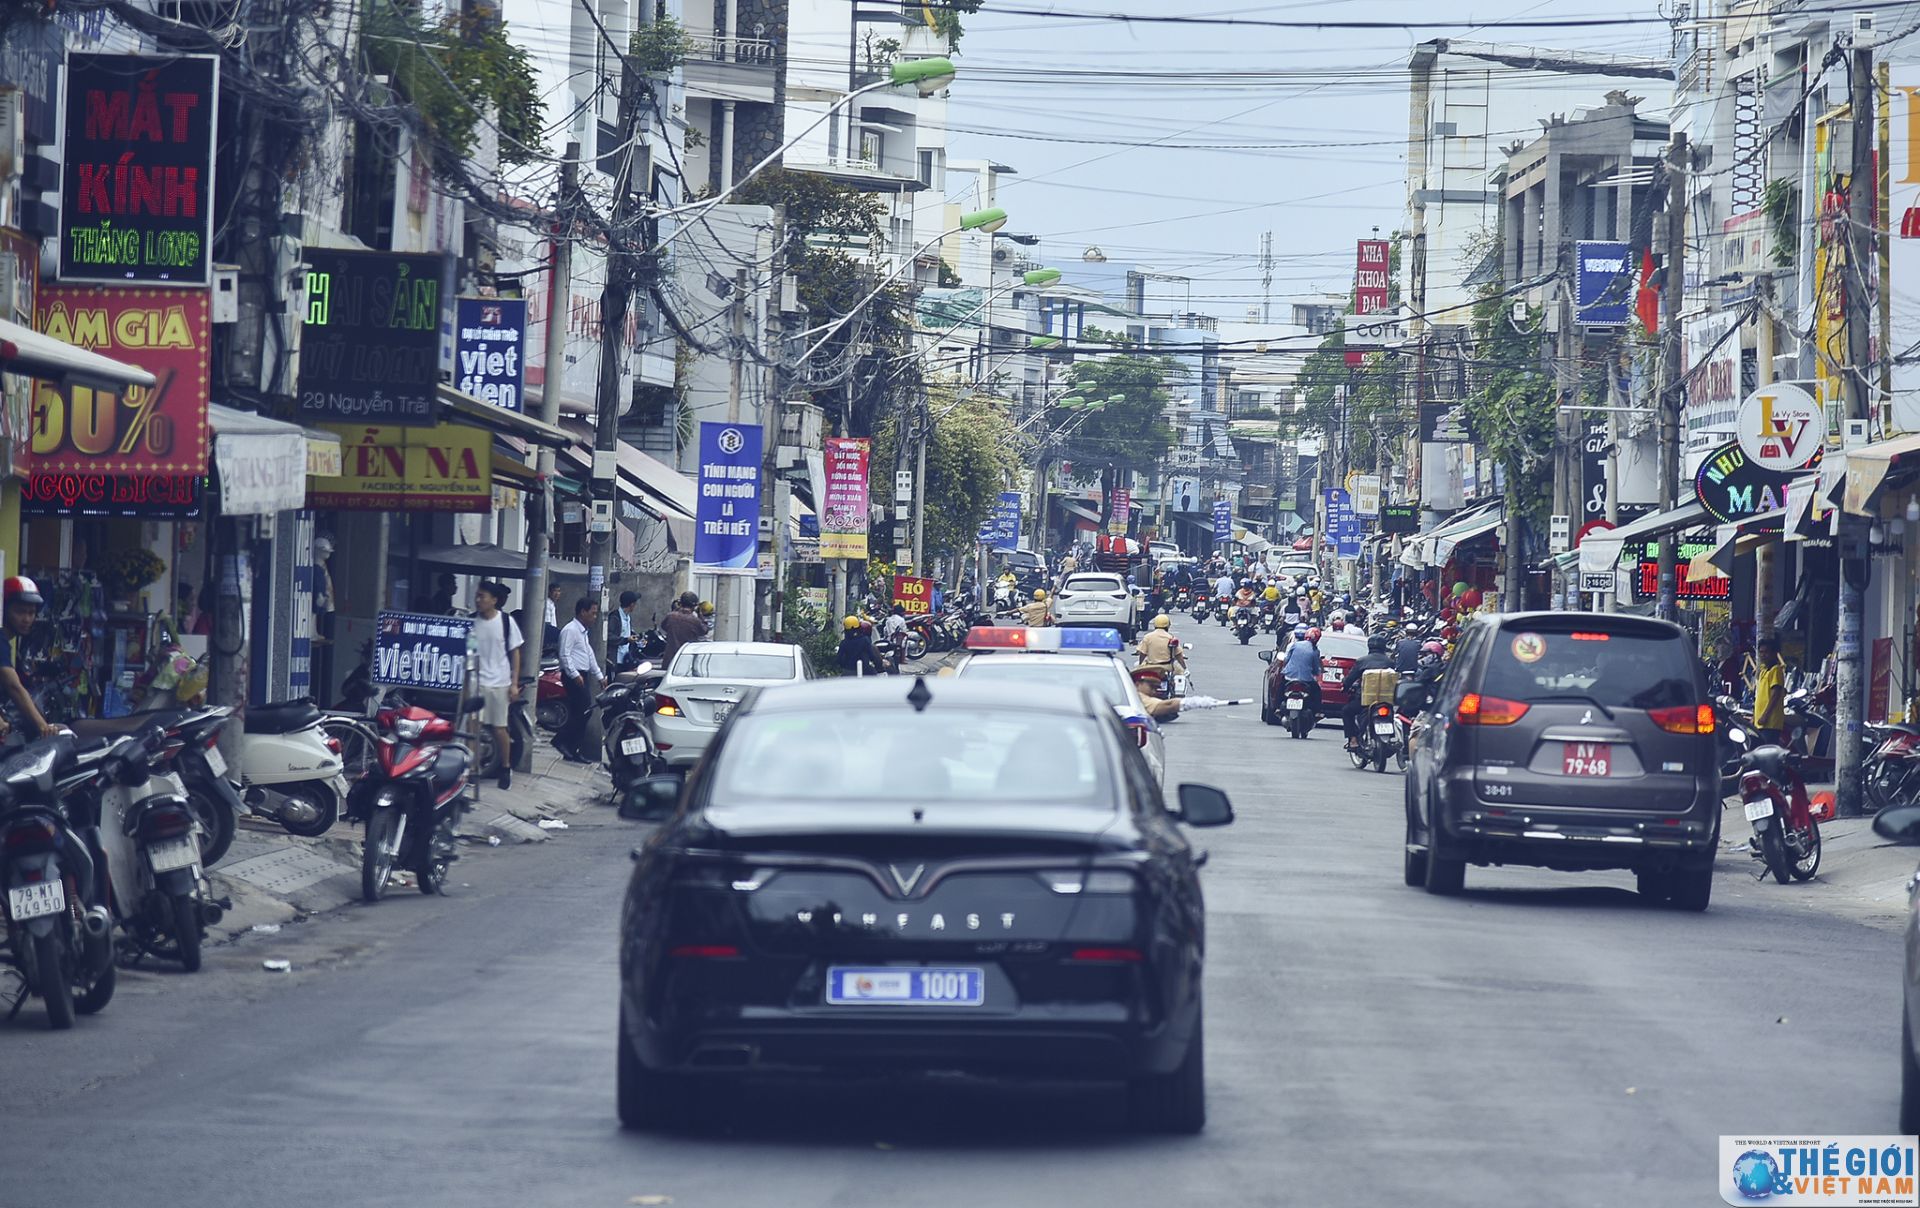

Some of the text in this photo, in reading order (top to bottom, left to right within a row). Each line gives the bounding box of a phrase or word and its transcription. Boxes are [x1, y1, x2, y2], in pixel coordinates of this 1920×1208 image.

[86, 68, 199, 143] MẮT
[78, 151, 198, 217] KÍNH
[145, 230, 200, 266] LONG
[1362, 245, 1383, 262] NHA
[1358, 270, 1386, 288] KHOA
[460, 343, 517, 377] viet
[303, 392, 325, 409] 29
[329, 390, 393, 415] Nguyễn
[424, 447, 481, 480] NA
[703, 463, 757, 482] TÍNH MẠNG
[703, 483, 724, 497] CON
[722, 500, 734, 516] LÀ
[703, 519, 751, 536] TRÊN HẾT
[1566, 758, 1607, 776] 79-68
[920, 972, 968, 1000] 1001
